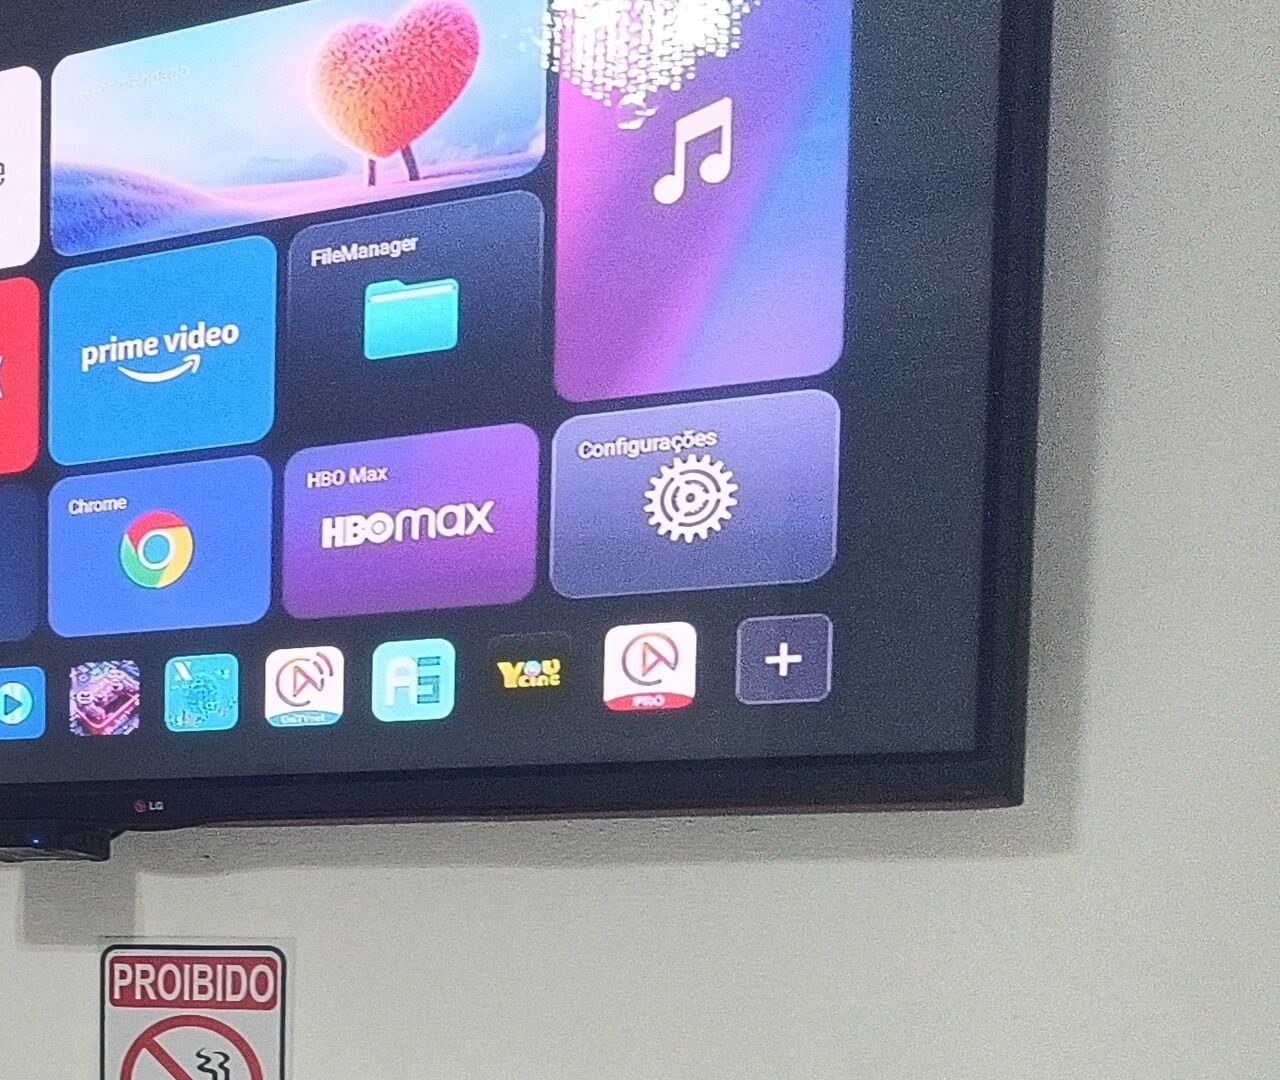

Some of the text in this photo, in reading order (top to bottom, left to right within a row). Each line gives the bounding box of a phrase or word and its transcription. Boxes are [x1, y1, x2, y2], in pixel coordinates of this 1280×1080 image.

[311, 236, 419, 267] FileManager
[81, 321, 239, 371] prime video
[578, 430, 718, 459] Configurações
[306, 466, 389, 488] HBO Max
[68, 495, 128, 516] Chrome
[113, 963, 275, 1002] PROIBIDO
